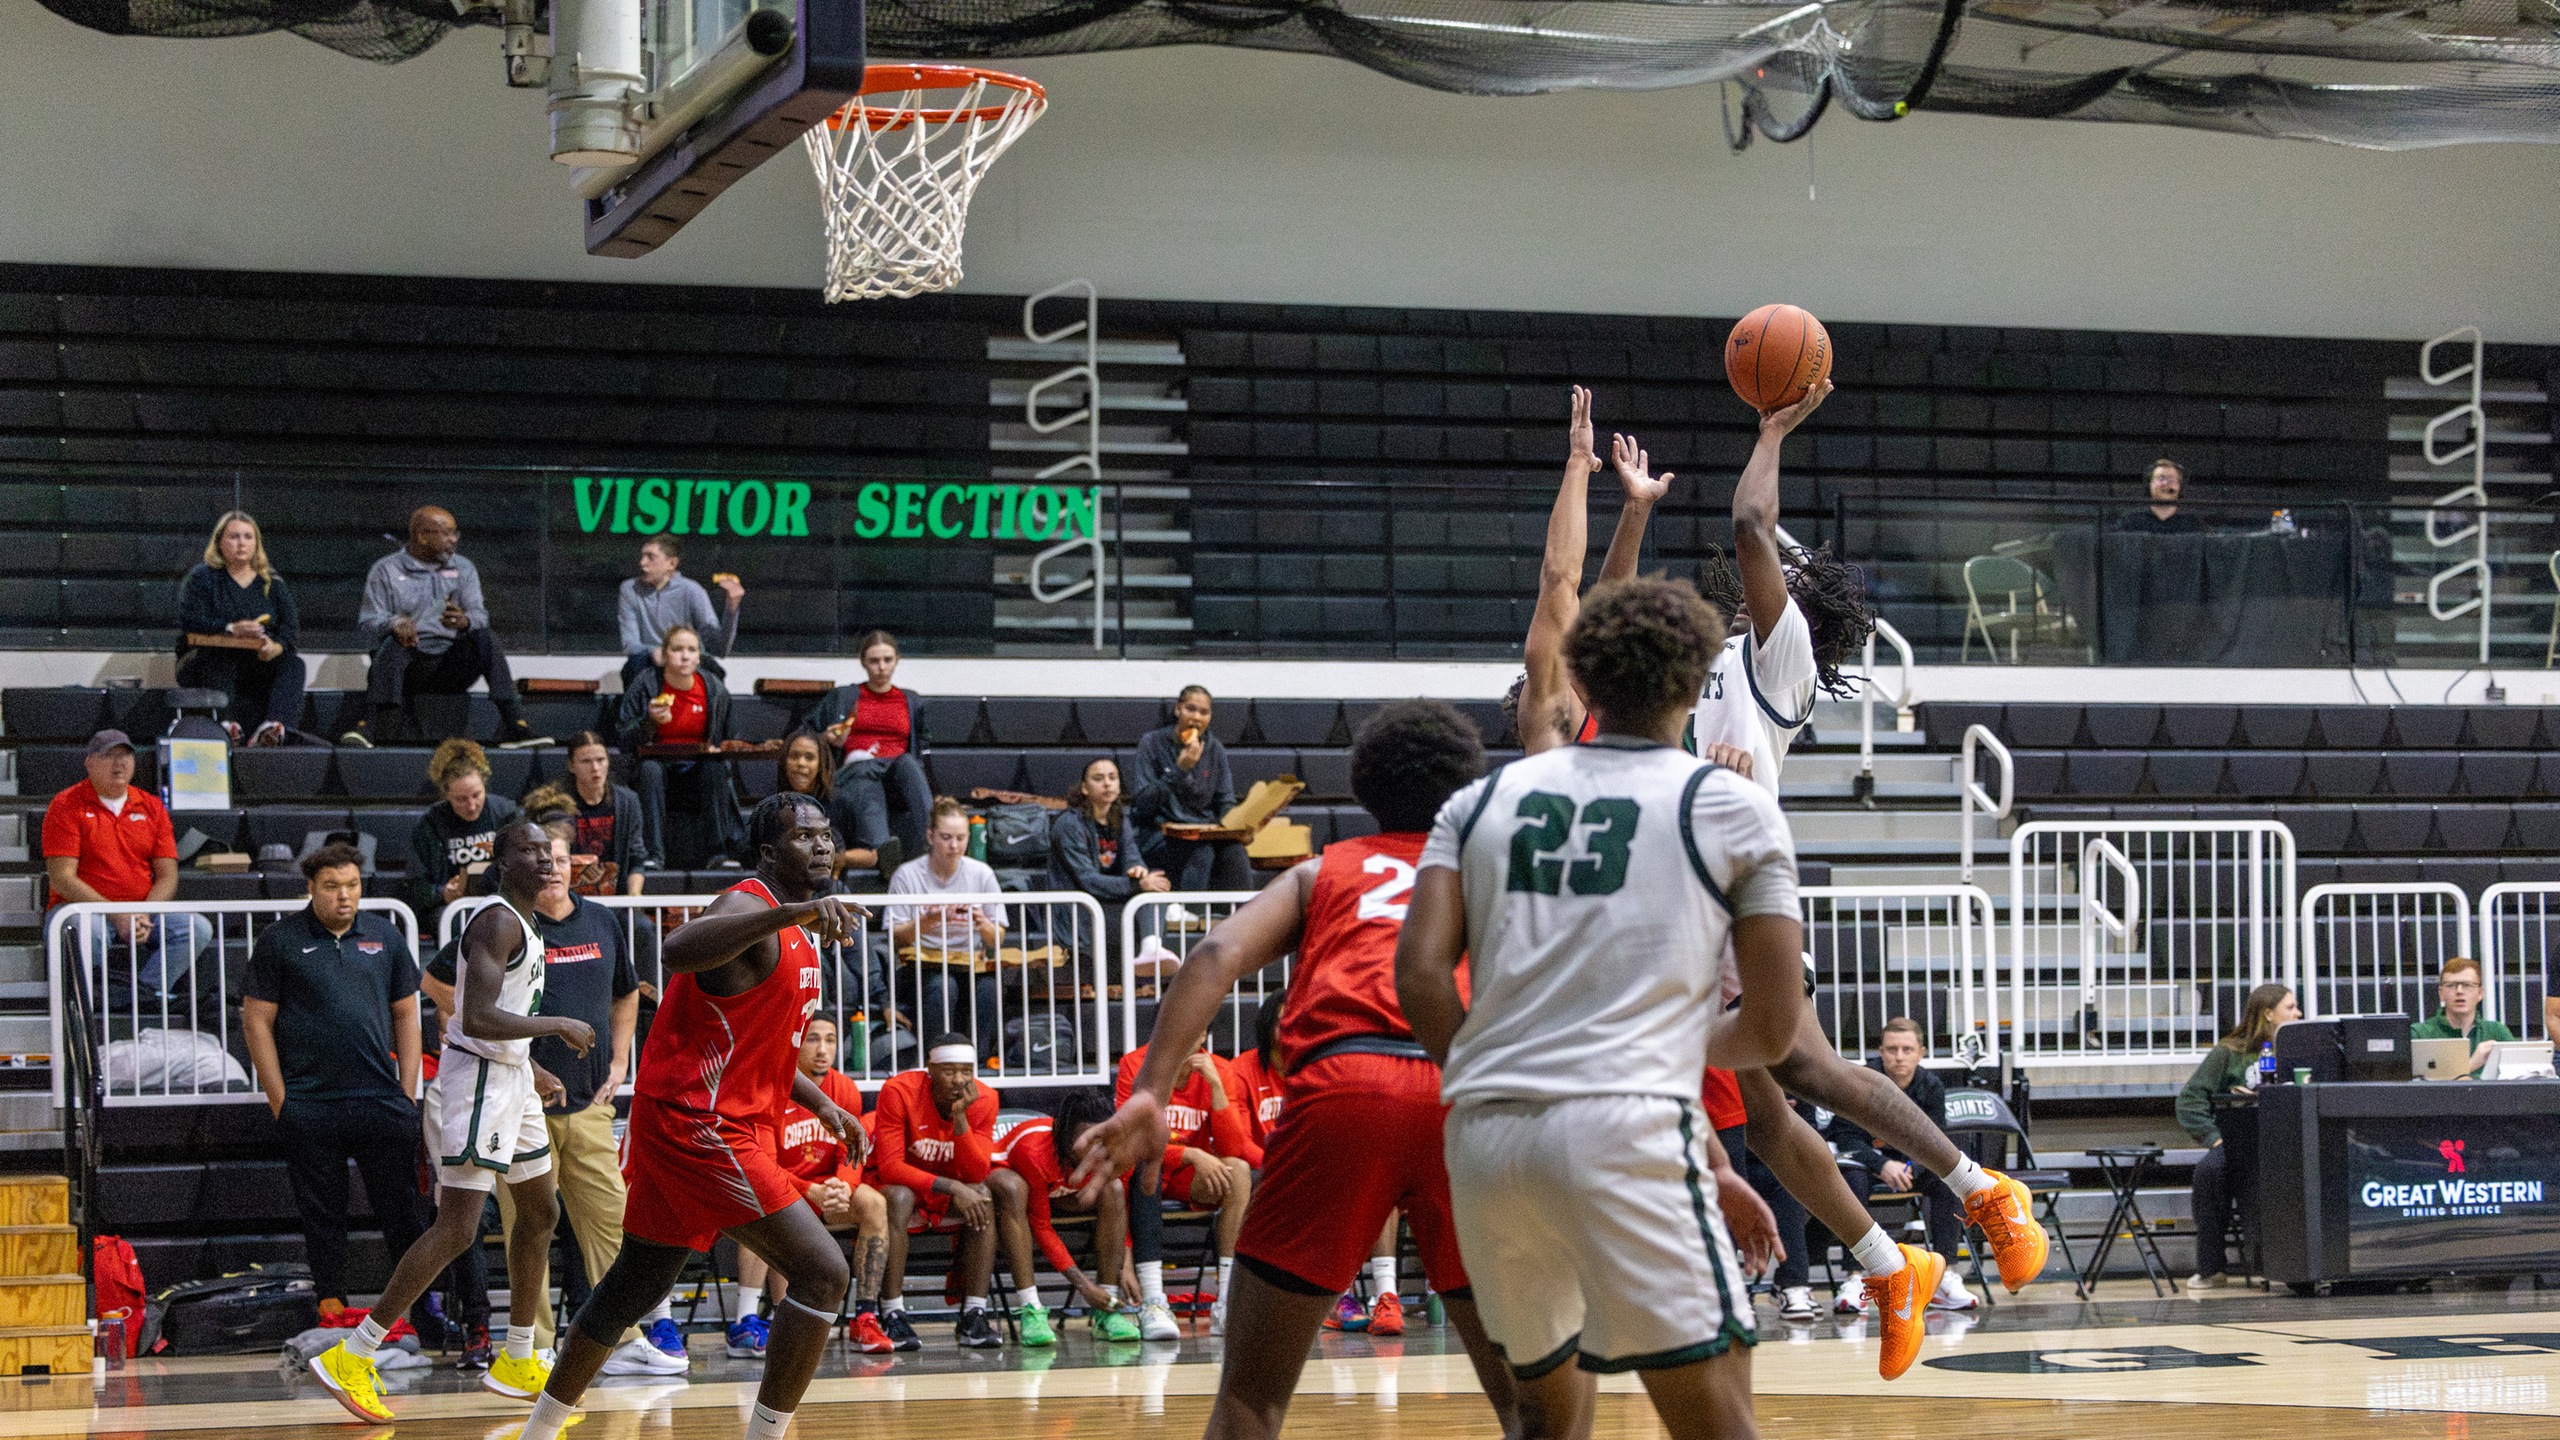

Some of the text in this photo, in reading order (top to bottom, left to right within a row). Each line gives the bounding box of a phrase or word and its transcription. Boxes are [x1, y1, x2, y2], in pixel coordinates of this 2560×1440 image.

[573, 477, 1098, 542] VISITOR SECTION
[1506, 789, 1642, 897] 23
[1945, 1099, 1995, 1118] SAINTS
[2362, 1179, 2544, 1208] GREAT WESTERN
[2403, 1205, 2501, 1217] DINING SERVICE
